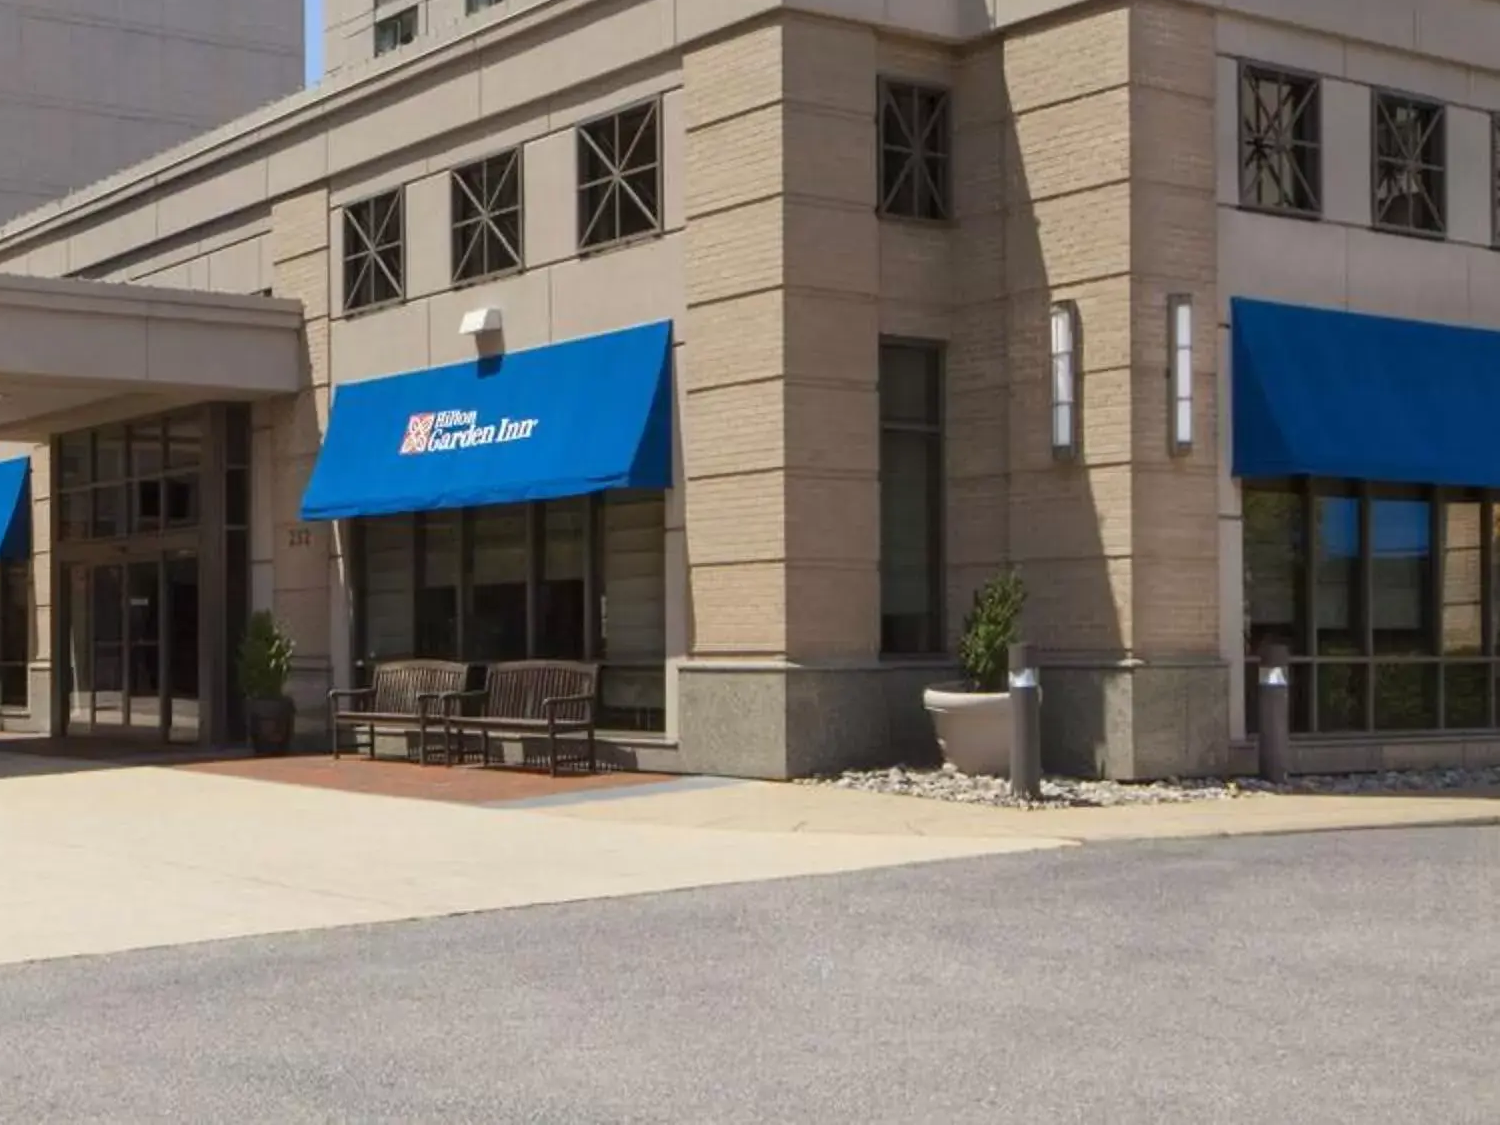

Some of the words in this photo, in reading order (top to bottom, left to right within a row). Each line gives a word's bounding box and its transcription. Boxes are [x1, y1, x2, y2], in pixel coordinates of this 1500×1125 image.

[435, 409, 477, 428] Hilton
[427, 424, 495, 452] Garden
[495, 418, 535, 443] Inn
